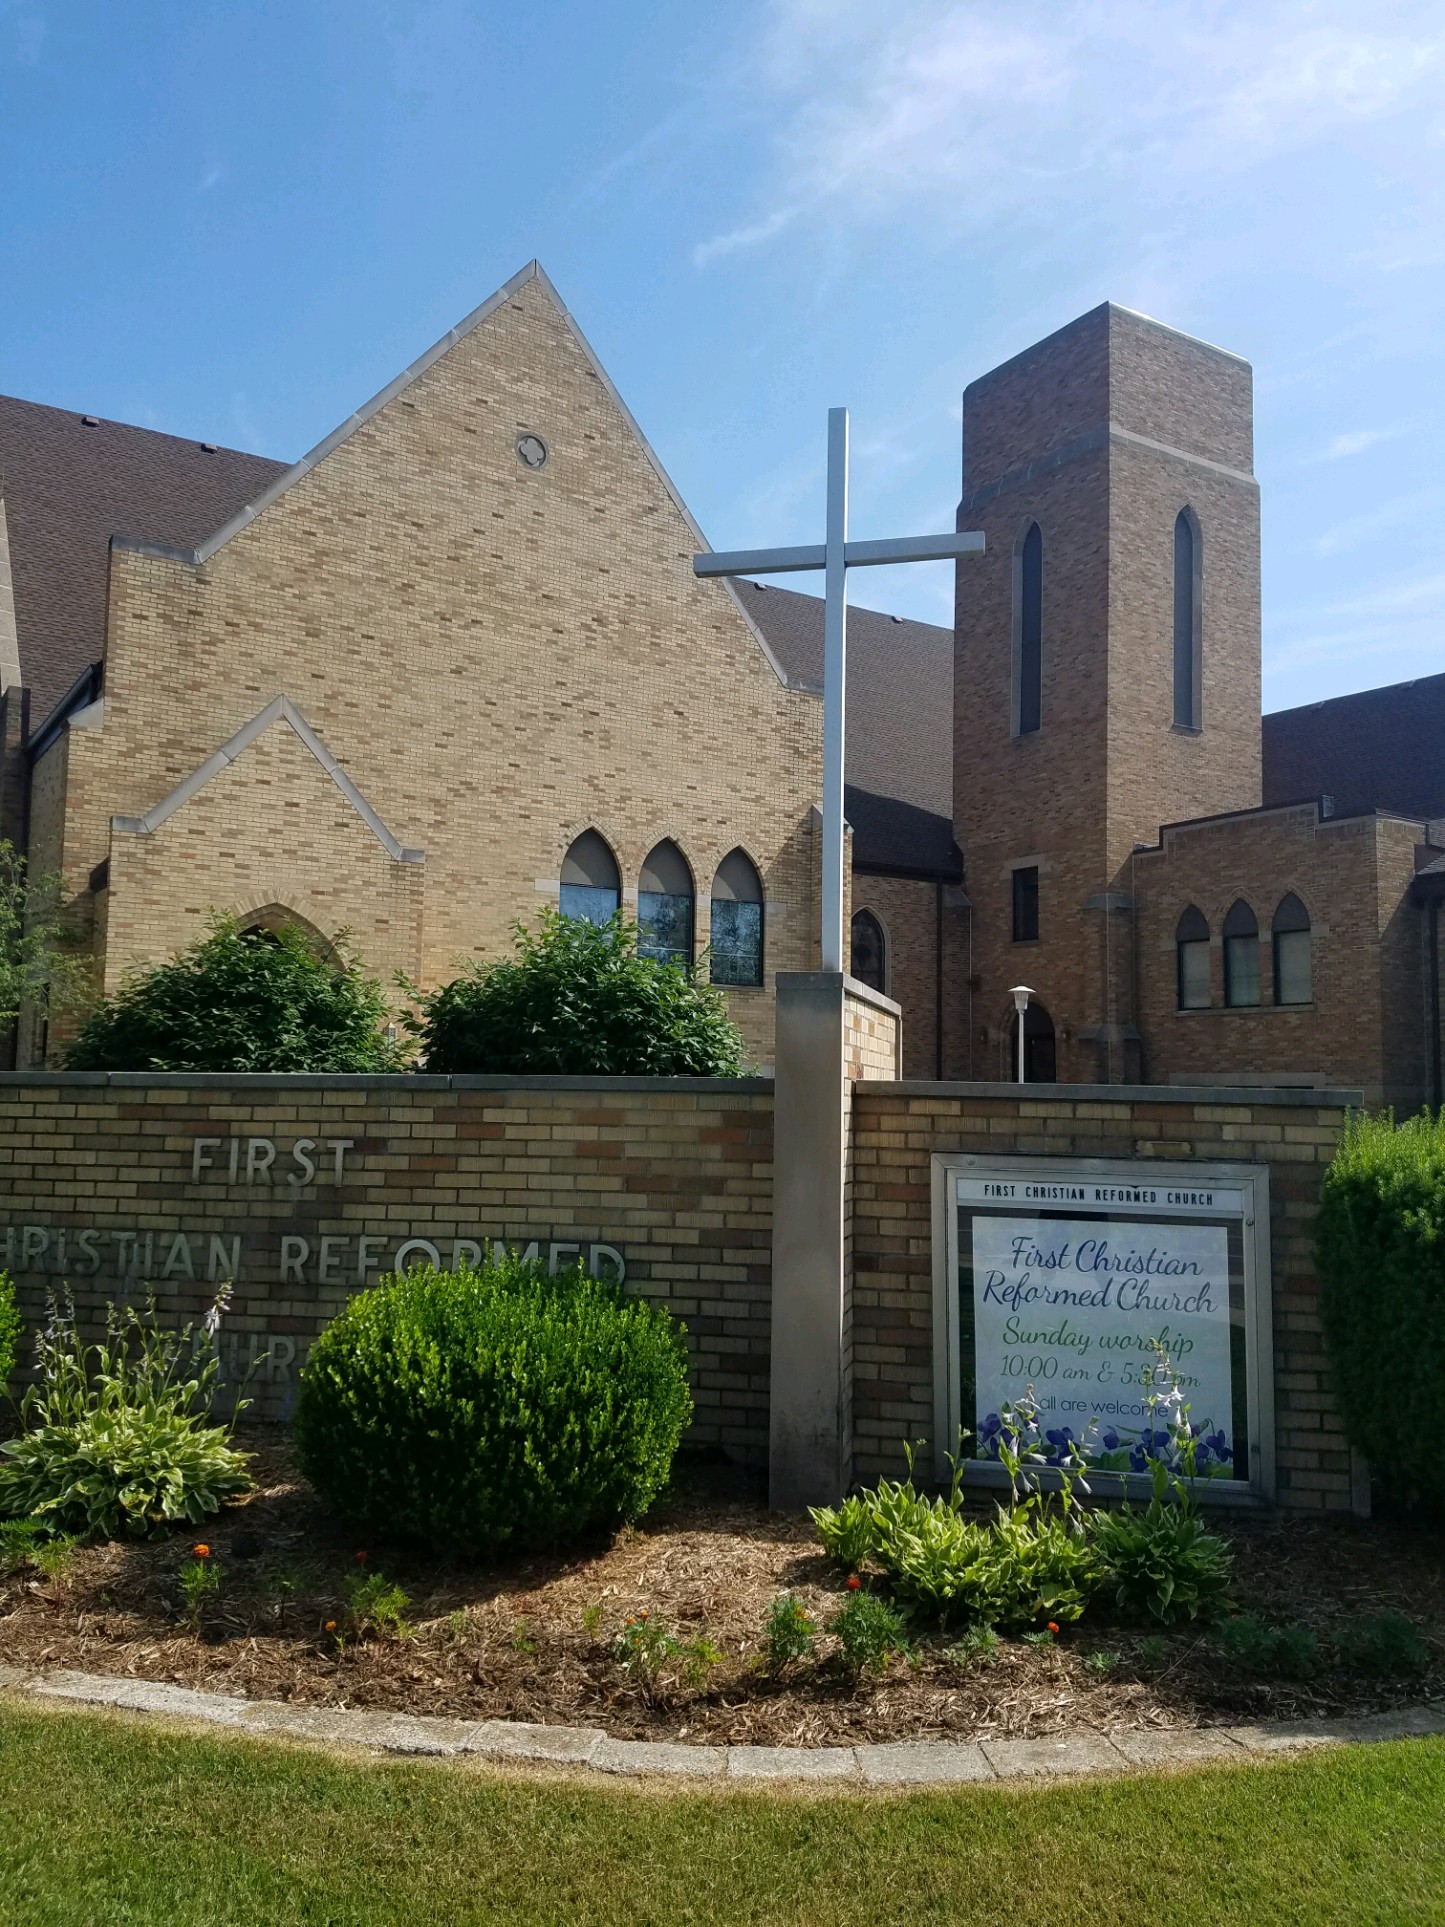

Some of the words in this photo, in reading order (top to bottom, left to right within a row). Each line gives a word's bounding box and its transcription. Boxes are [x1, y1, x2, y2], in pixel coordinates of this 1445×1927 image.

[191, 1138, 354, 1187] FIRST
[984, 1184, 1015, 1197] FIRST
[1025, 1186, 1085, 1200] CHRISTIAN
[1095, 1189, 1156, 1203] REFORMED
[1167, 1192, 1213, 1206] CHURCH
[1011, 1236, 1070, 1269] First
[1075, 1239, 1203, 1276] Christian
[983, 1270, 1113, 1312] Reformed
[1117, 1277, 1217, 1313] Church
[1002, 1315, 1092, 1356] Sunday
[1000, 1354, 1058, 1379] 10:00
[1062, 1367, 1090, 1380] am
[1097, 1360, 1115, 1383] &
[1040, 1395, 1056, 1410] all
[1060, 1400, 1087, 1412] are
[1091, 1400, 1168, 1418] welcome
